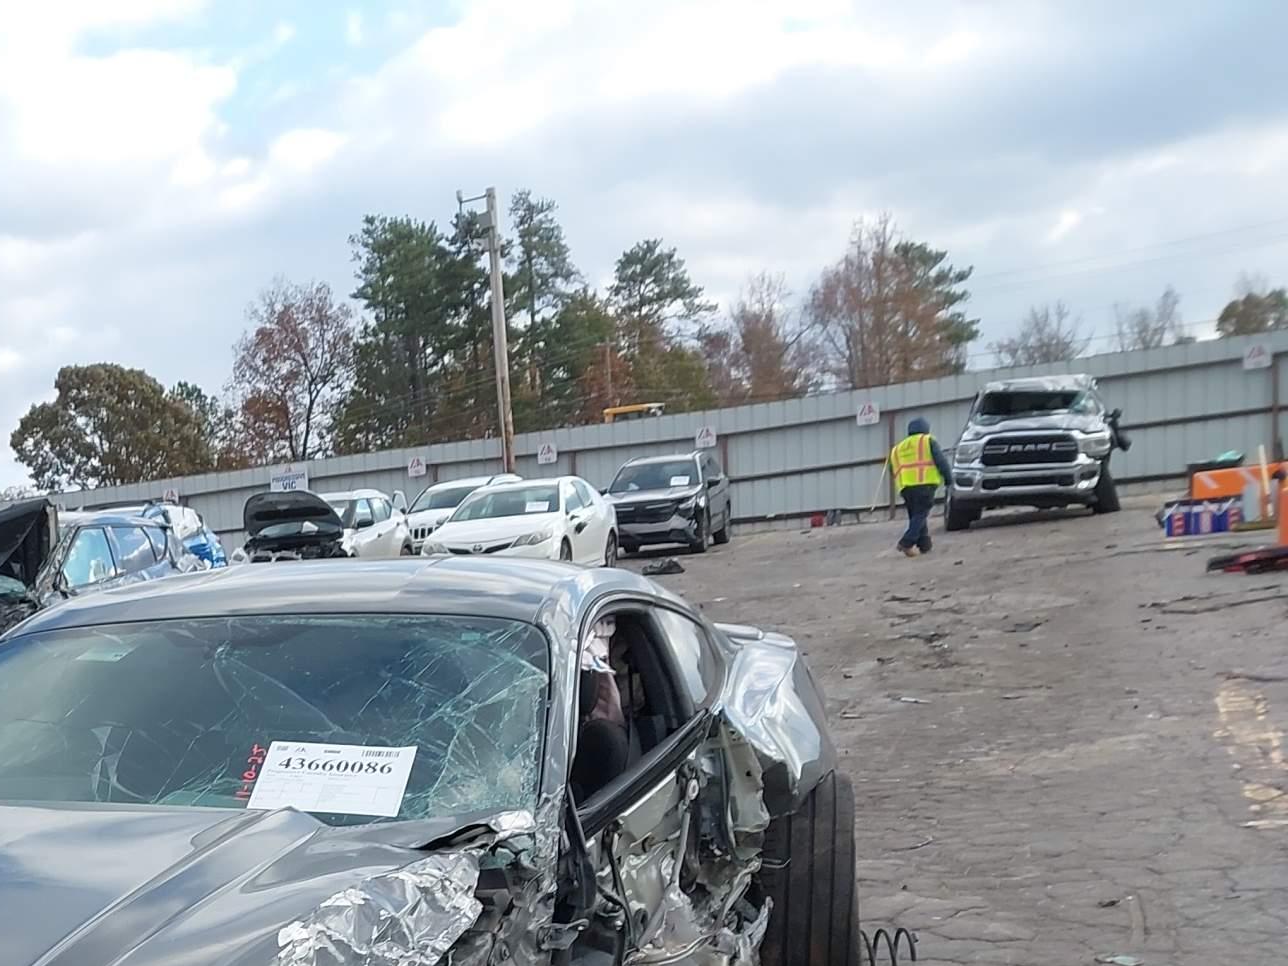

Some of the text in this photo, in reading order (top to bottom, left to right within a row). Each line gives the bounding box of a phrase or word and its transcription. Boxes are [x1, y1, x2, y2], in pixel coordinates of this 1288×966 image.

[1010, 443, 1050, 452] RAM
[282, 480, 297, 490] VIC
[234, 743, 267, 800] 11-10-25
[278, 756, 393, 775] 43660086
